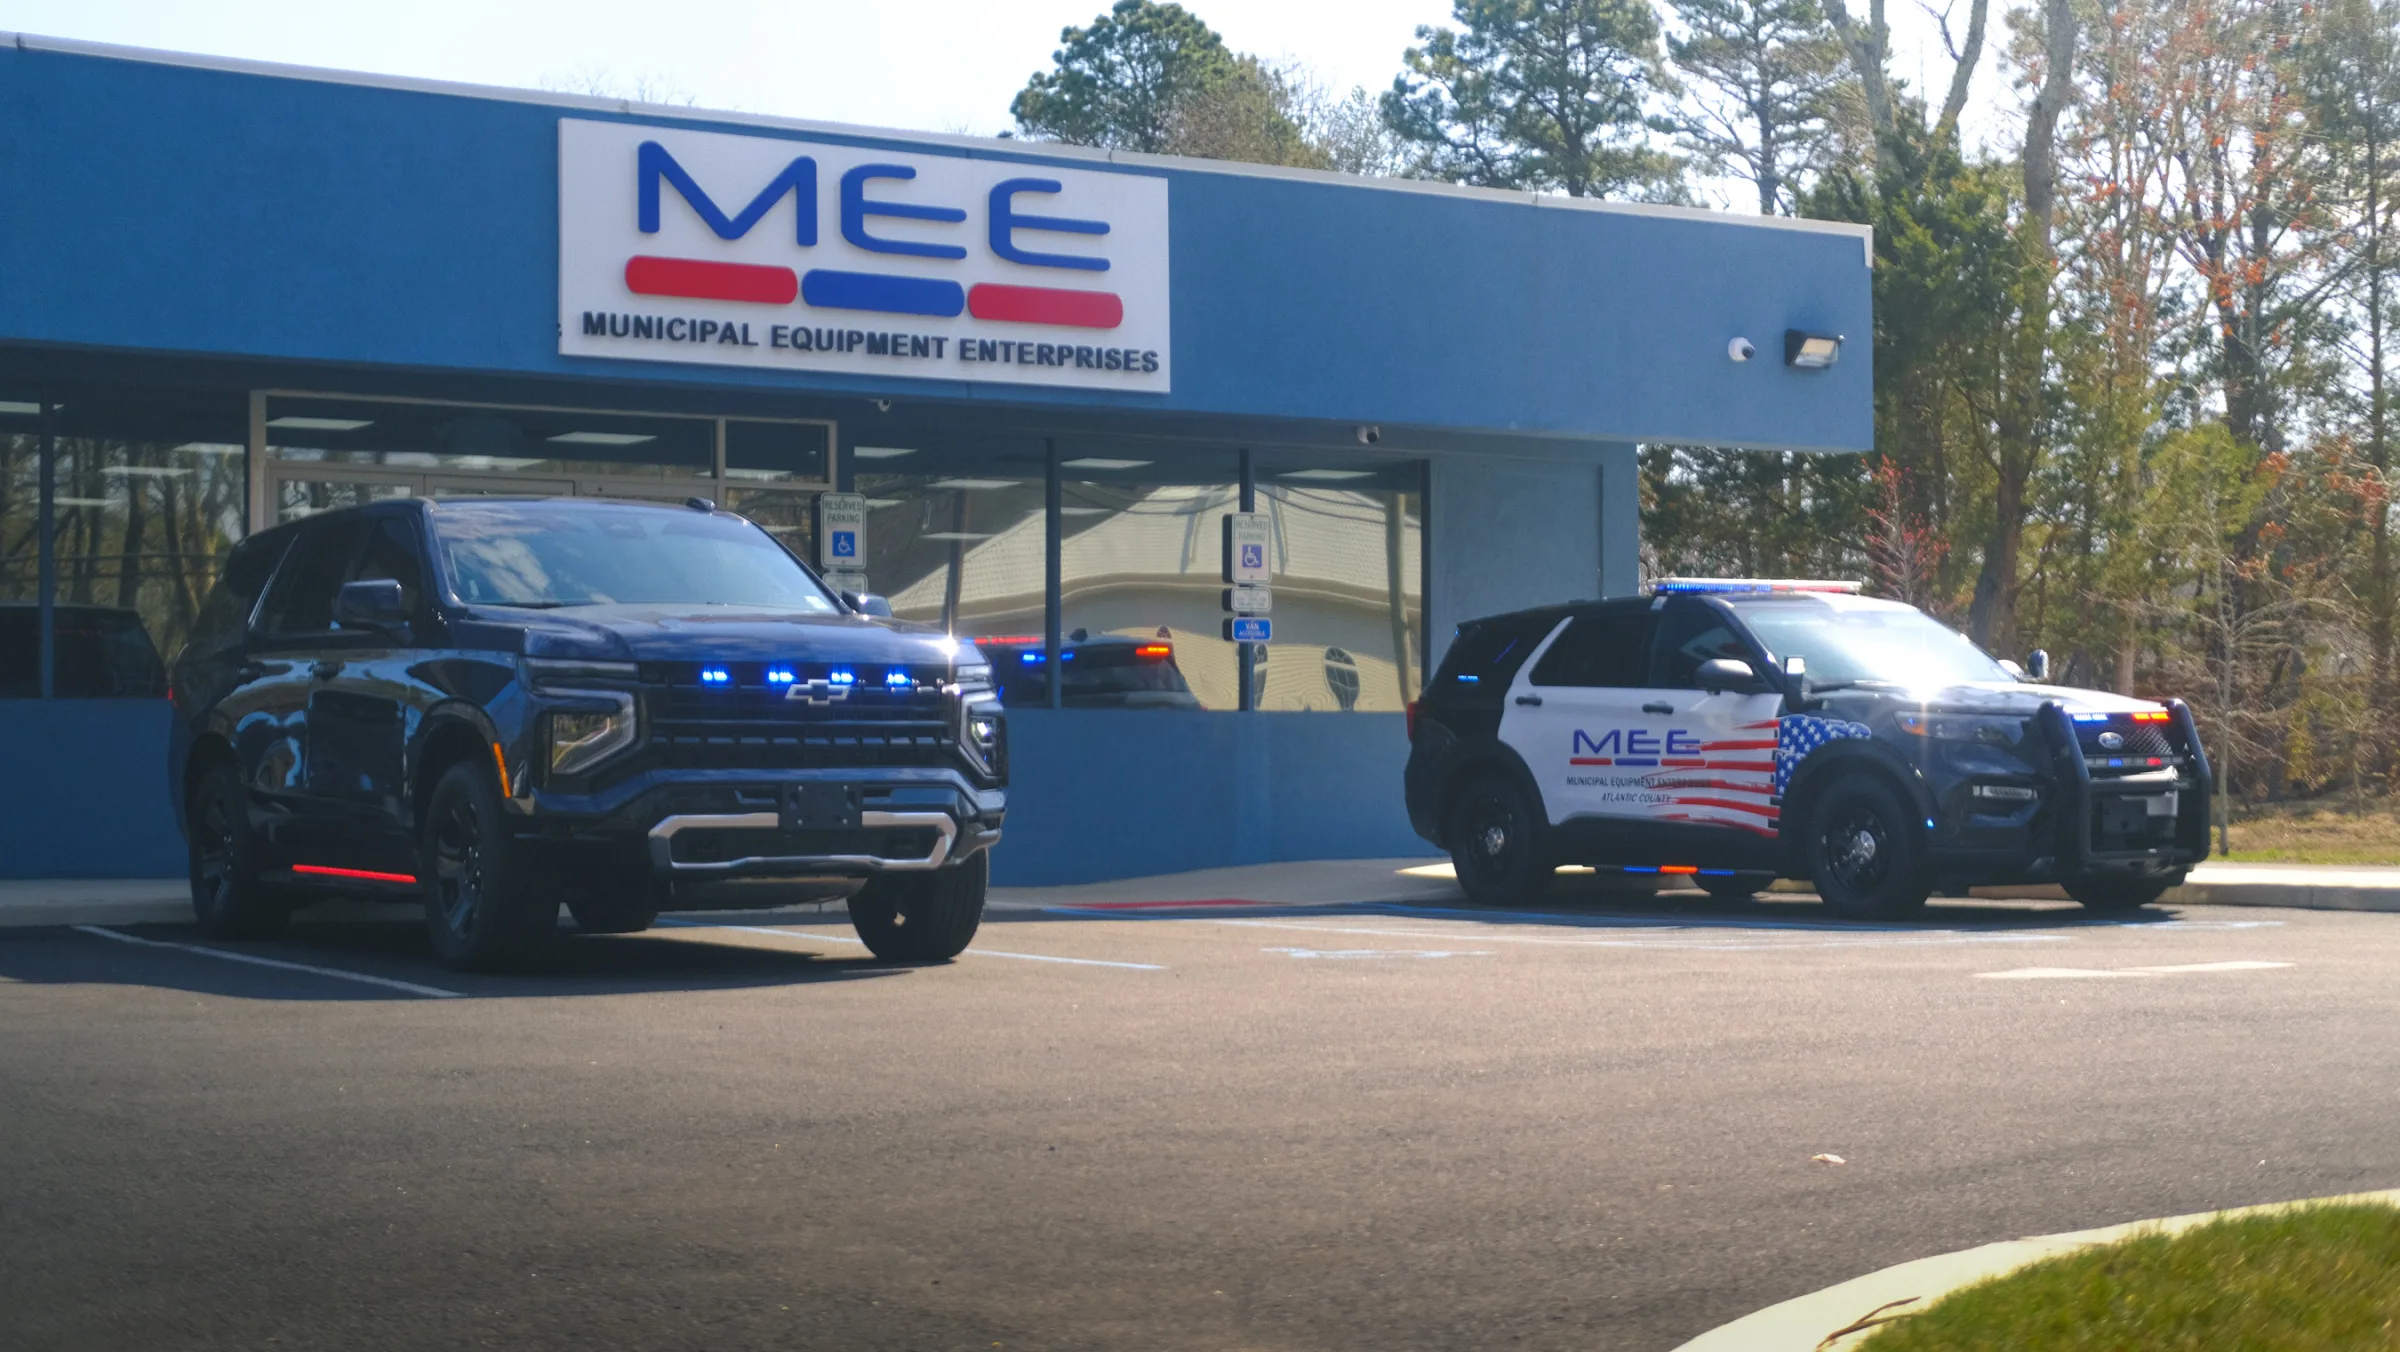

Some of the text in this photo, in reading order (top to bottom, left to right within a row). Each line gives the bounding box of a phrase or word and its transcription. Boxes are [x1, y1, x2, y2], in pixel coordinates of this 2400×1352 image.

[637, 140, 1111, 271] MEE
[582, 311, 1160, 373] MUNICIPAL EQUIPMENT ENTERPRISES
[824, 500, 862, 511] RESERVED
[828, 512, 860, 523] PARKING
[1573, 729, 1700, 755] MEE
[1566, 776, 1608, 786] MUNICIPAL
[1610, 776, 1655, 788] EQUIPMENT
[1601, 792, 1672, 803] ATLANTIC COUNTY
